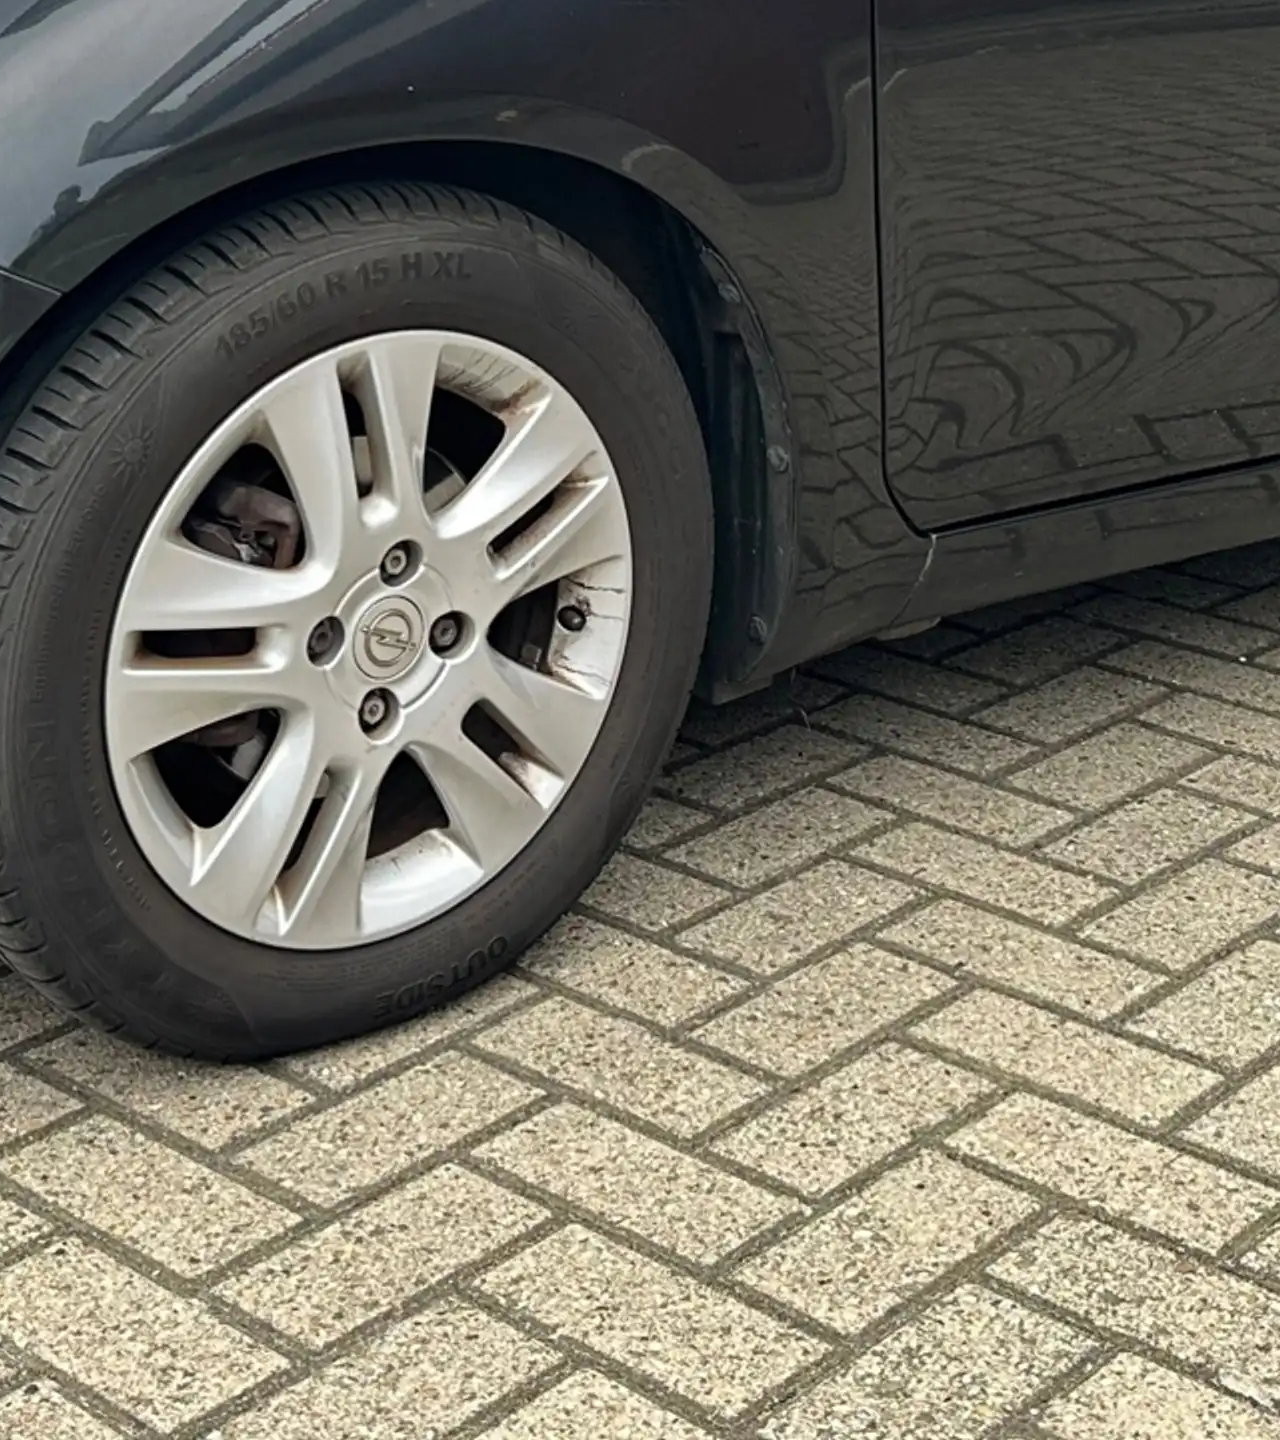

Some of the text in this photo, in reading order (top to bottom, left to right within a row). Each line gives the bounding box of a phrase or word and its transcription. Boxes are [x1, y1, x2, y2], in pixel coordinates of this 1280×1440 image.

[213, 250, 473, 359] 185/60 R 15 H XL
[373, 935, 508, 1019] OUTSIDE
